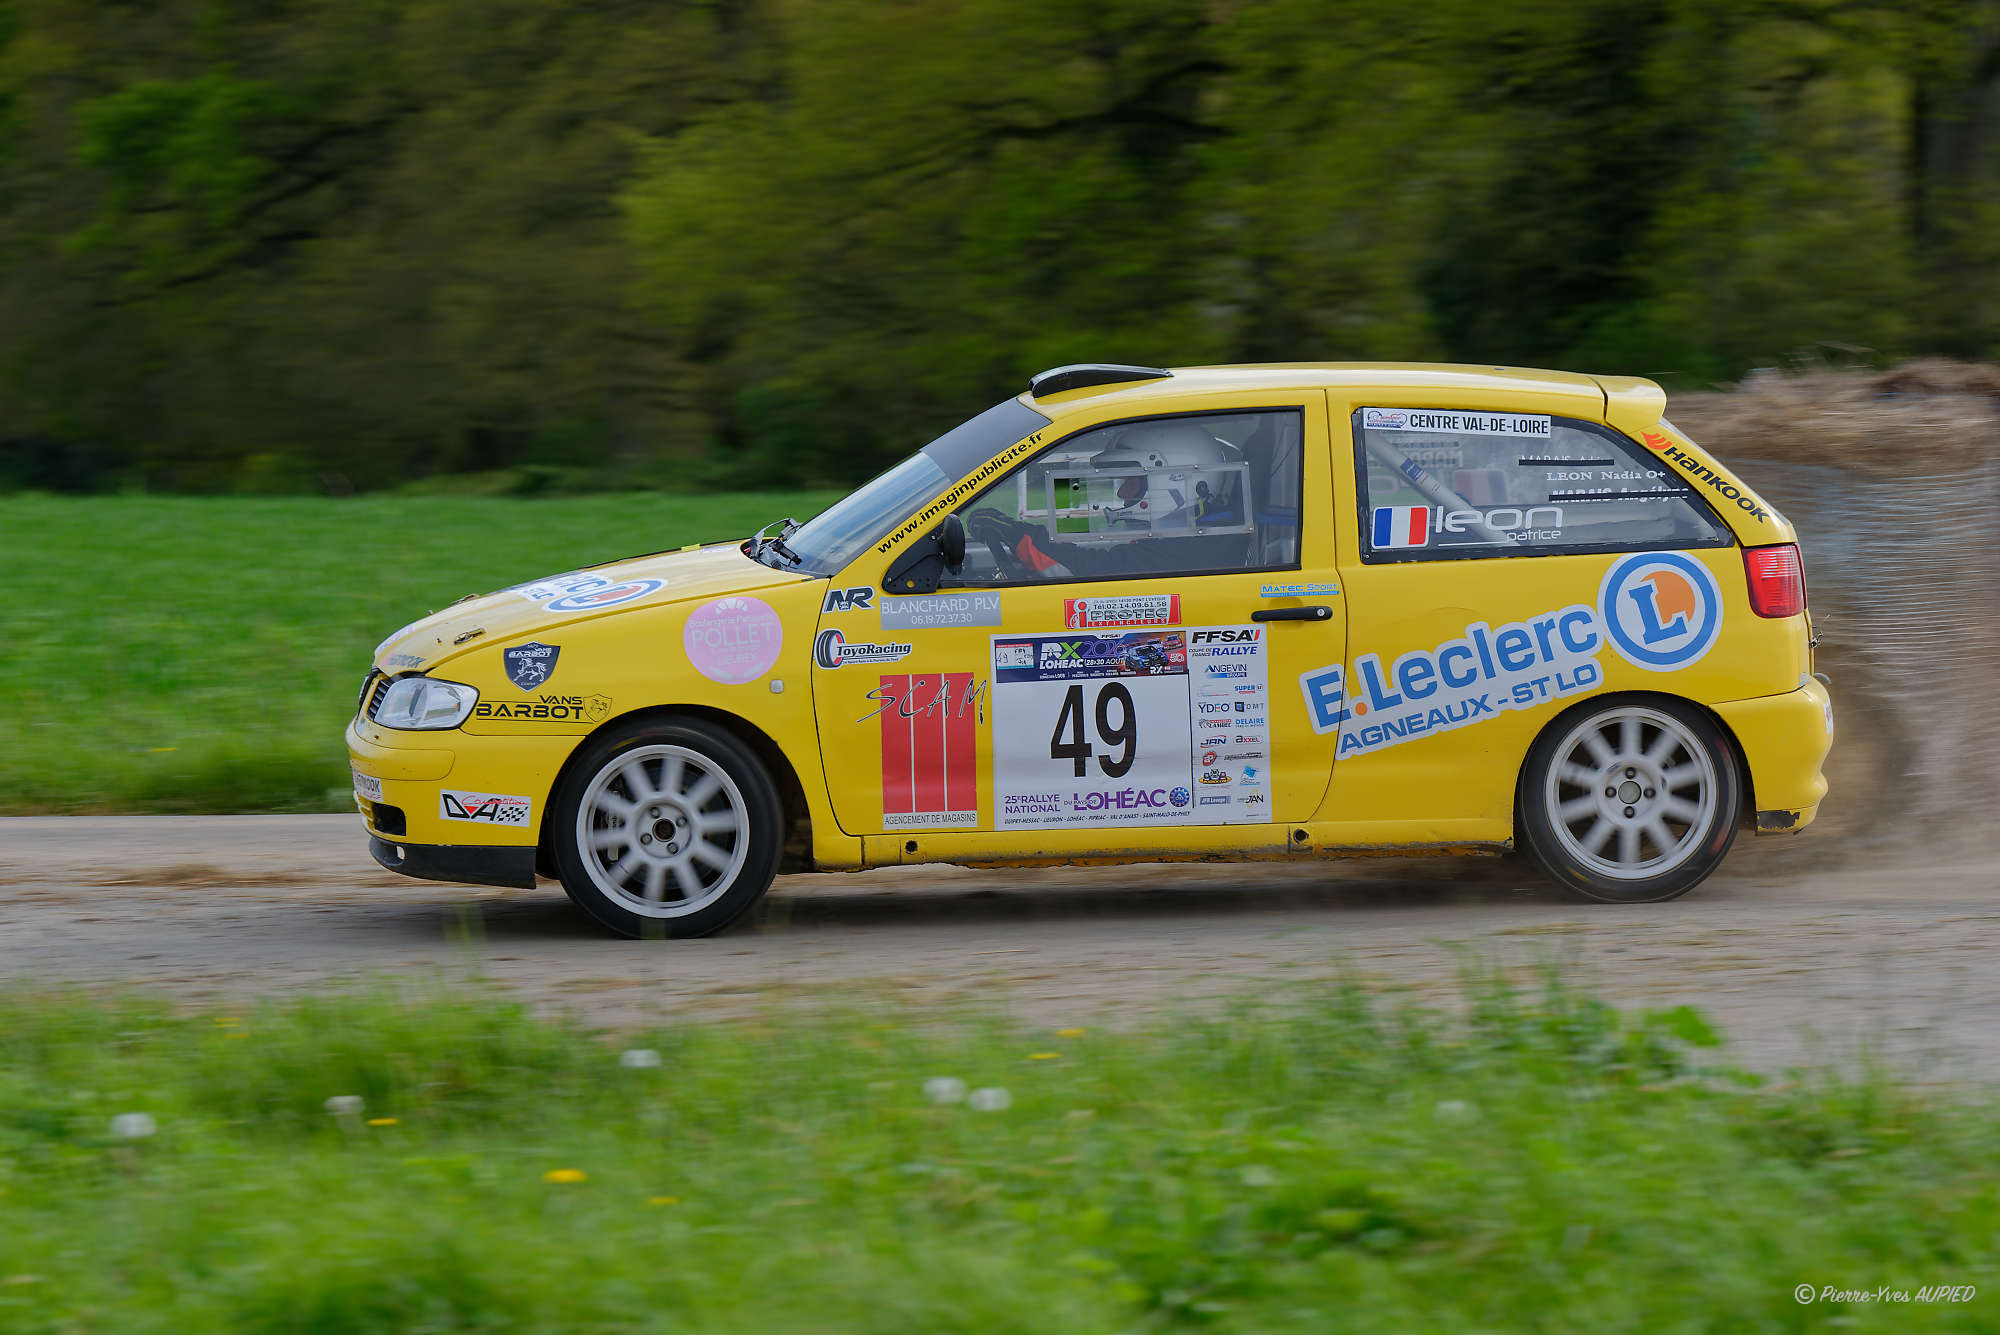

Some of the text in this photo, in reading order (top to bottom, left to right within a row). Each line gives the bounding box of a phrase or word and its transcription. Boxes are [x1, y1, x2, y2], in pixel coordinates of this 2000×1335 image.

[1410, 414, 1459, 429] CENTRE
[1463, 417, 1549, 434] VAL-DE-LOIRE
[1546, 472, 1593, 481] LEON
[1601, 471, 1642, 480] Nadia
[877, 432, 1043, 554] www.imaginpublicite.fr
[1435, 505, 1563, 533] leon
[1507, 529, 1561, 543] patrice
[881, 596, 1001, 614] BLANCHARD PLV
[911, 613, 973, 625] 06.19.72.37.30
[691, 622, 776, 648] POLLET
[1192, 630, 1253, 643] FFSA
[837, 643, 911, 657] ToyoRacing
[1212, 646, 1258, 656] RALLYE
[1040, 659, 1083, 669] LOHEAC
[1307, 610, 1597, 728] E.Leclerc
[539, 695, 583, 705] VANS
[856, 679, 987, 726] SCAM
[476, 703, 584, 719] BARBOT
[1341, 693, 1493, 754] AGNEAUX
[1560, 663, 1597, 690] LO
[1051, 681, 1137, 778] 49
[1073, 787, 1167, 811] LOHÉAC
[1005, 804, 1061, 814] NATIONAL
[885, 813, 976, 825] AGENCEMENT DE MAGASINS
